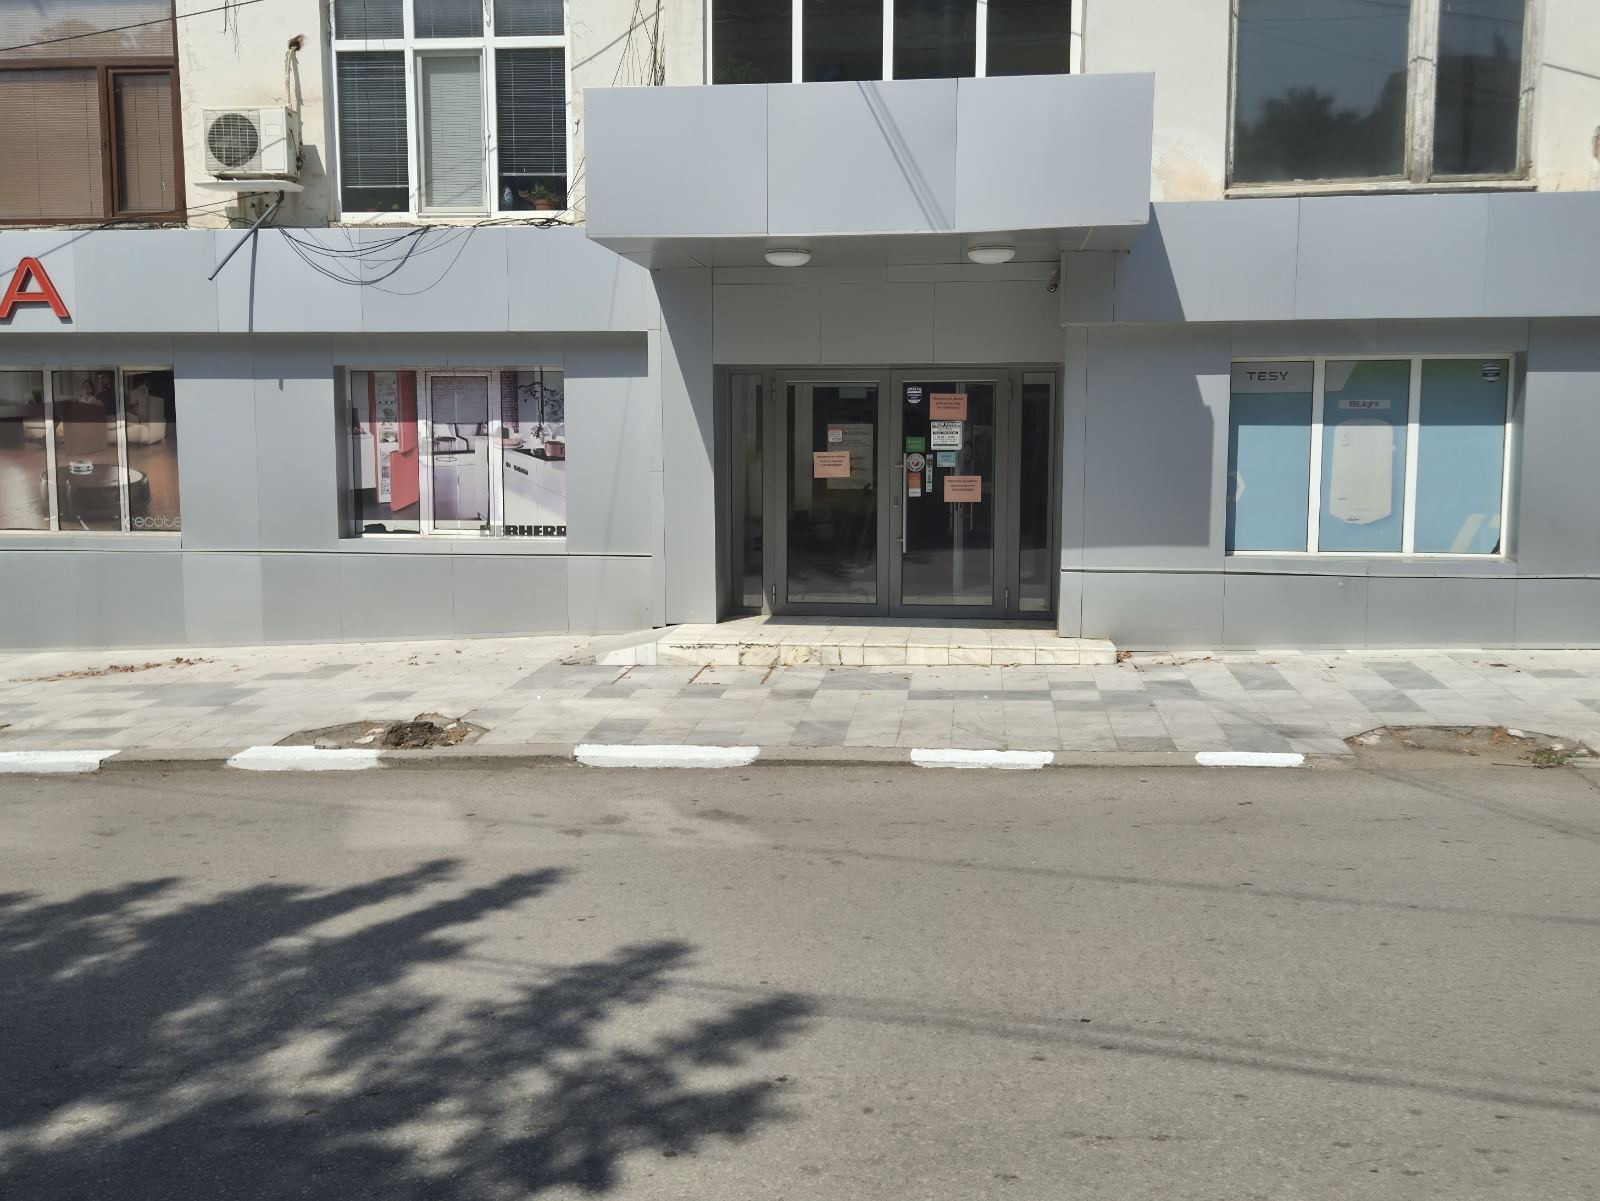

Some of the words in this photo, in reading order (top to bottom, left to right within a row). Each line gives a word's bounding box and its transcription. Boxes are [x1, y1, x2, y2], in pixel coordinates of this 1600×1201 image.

[0, 256, 71, 319] A
[1246, 371, 1288, 381] TESY
[480, 525, 567, 537] BHERR
